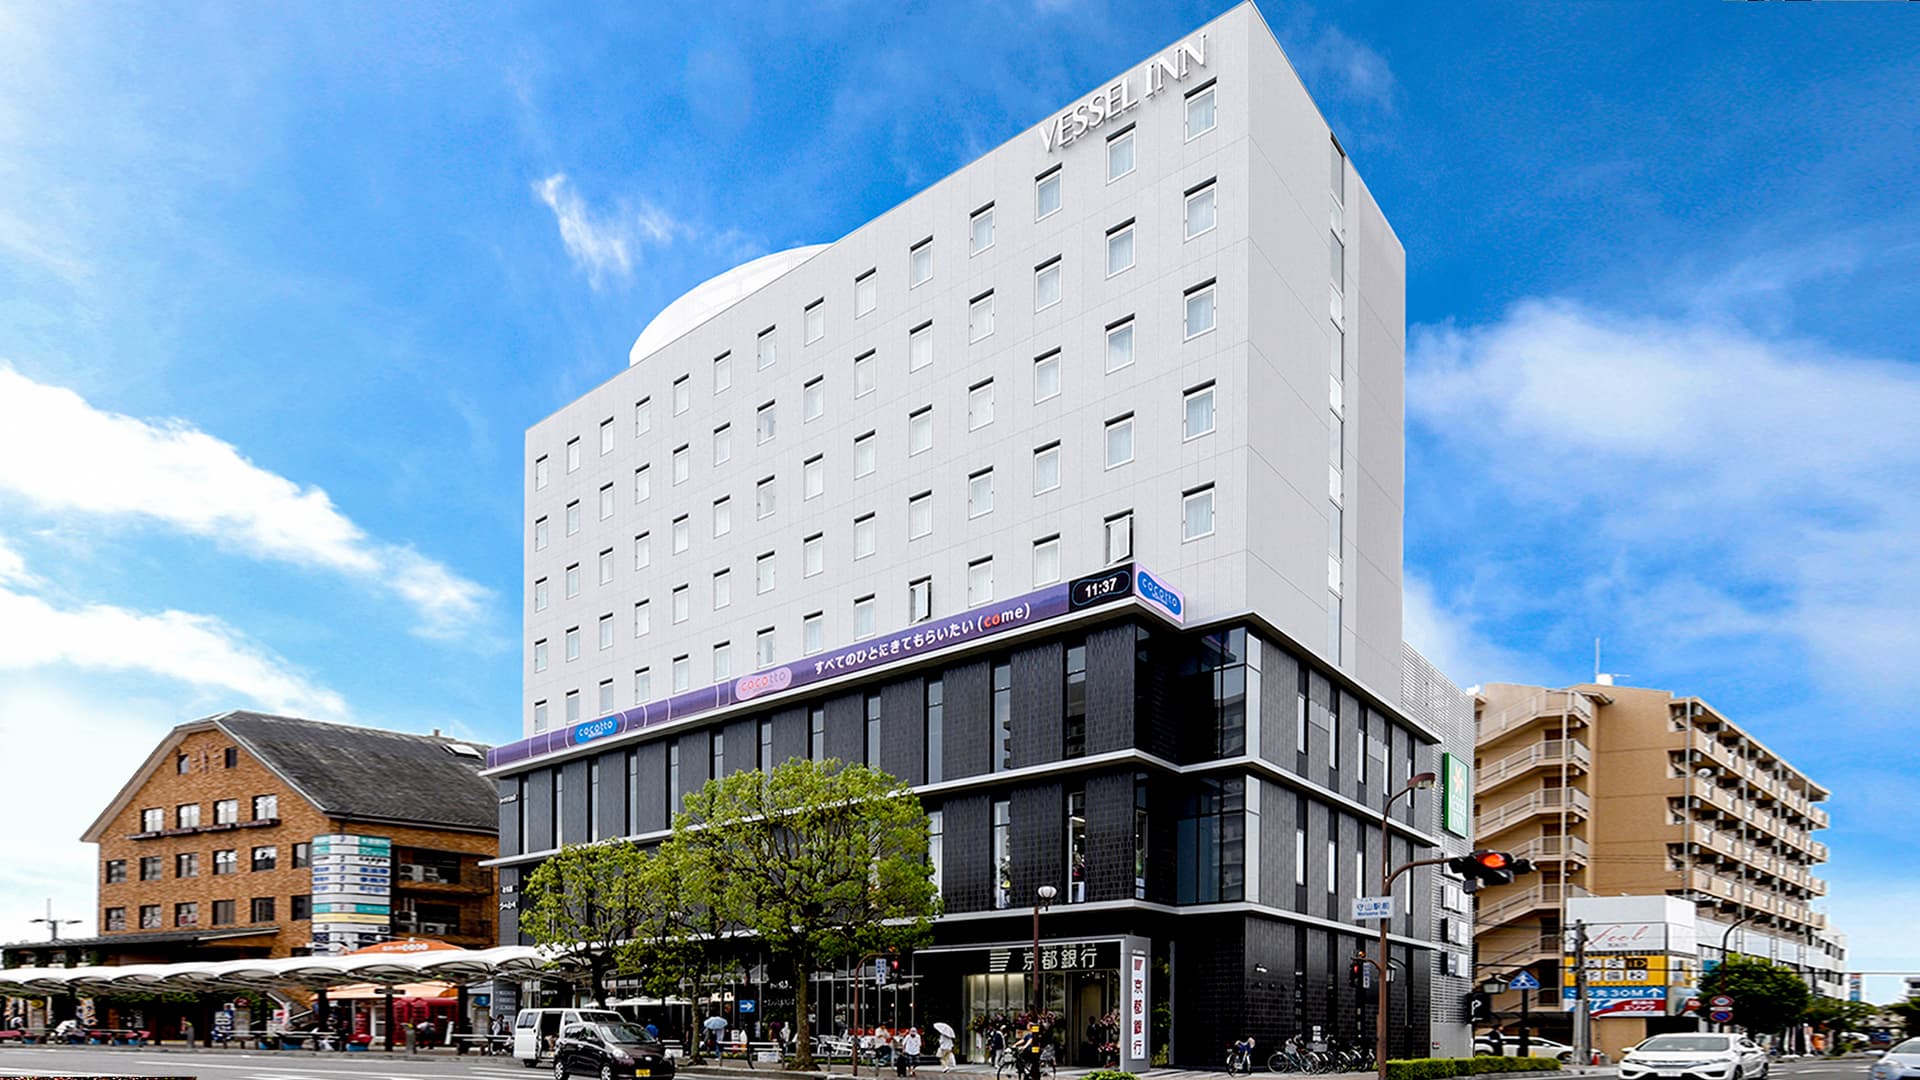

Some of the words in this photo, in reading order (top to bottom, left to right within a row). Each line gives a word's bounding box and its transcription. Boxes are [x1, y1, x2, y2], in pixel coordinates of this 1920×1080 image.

[1039, 77, 1139, 153] VESSEL
[1145, 32, 1207, 99] INN
[1085, 577, 1117, 598] 11:37
[1142, 578, 1177, 606] cocotto
[814, 619, 974, 675] すべてのひとにきてもらいたい
[977, 602, 1030, 632] (come)
[740, 670, 786, 693] cocotto
[578, 720, 613, 737] cocotto
[1023, 948, 1097, 970] 京都銀行
[1133, 979, 1144, 1055] 京都銀行
